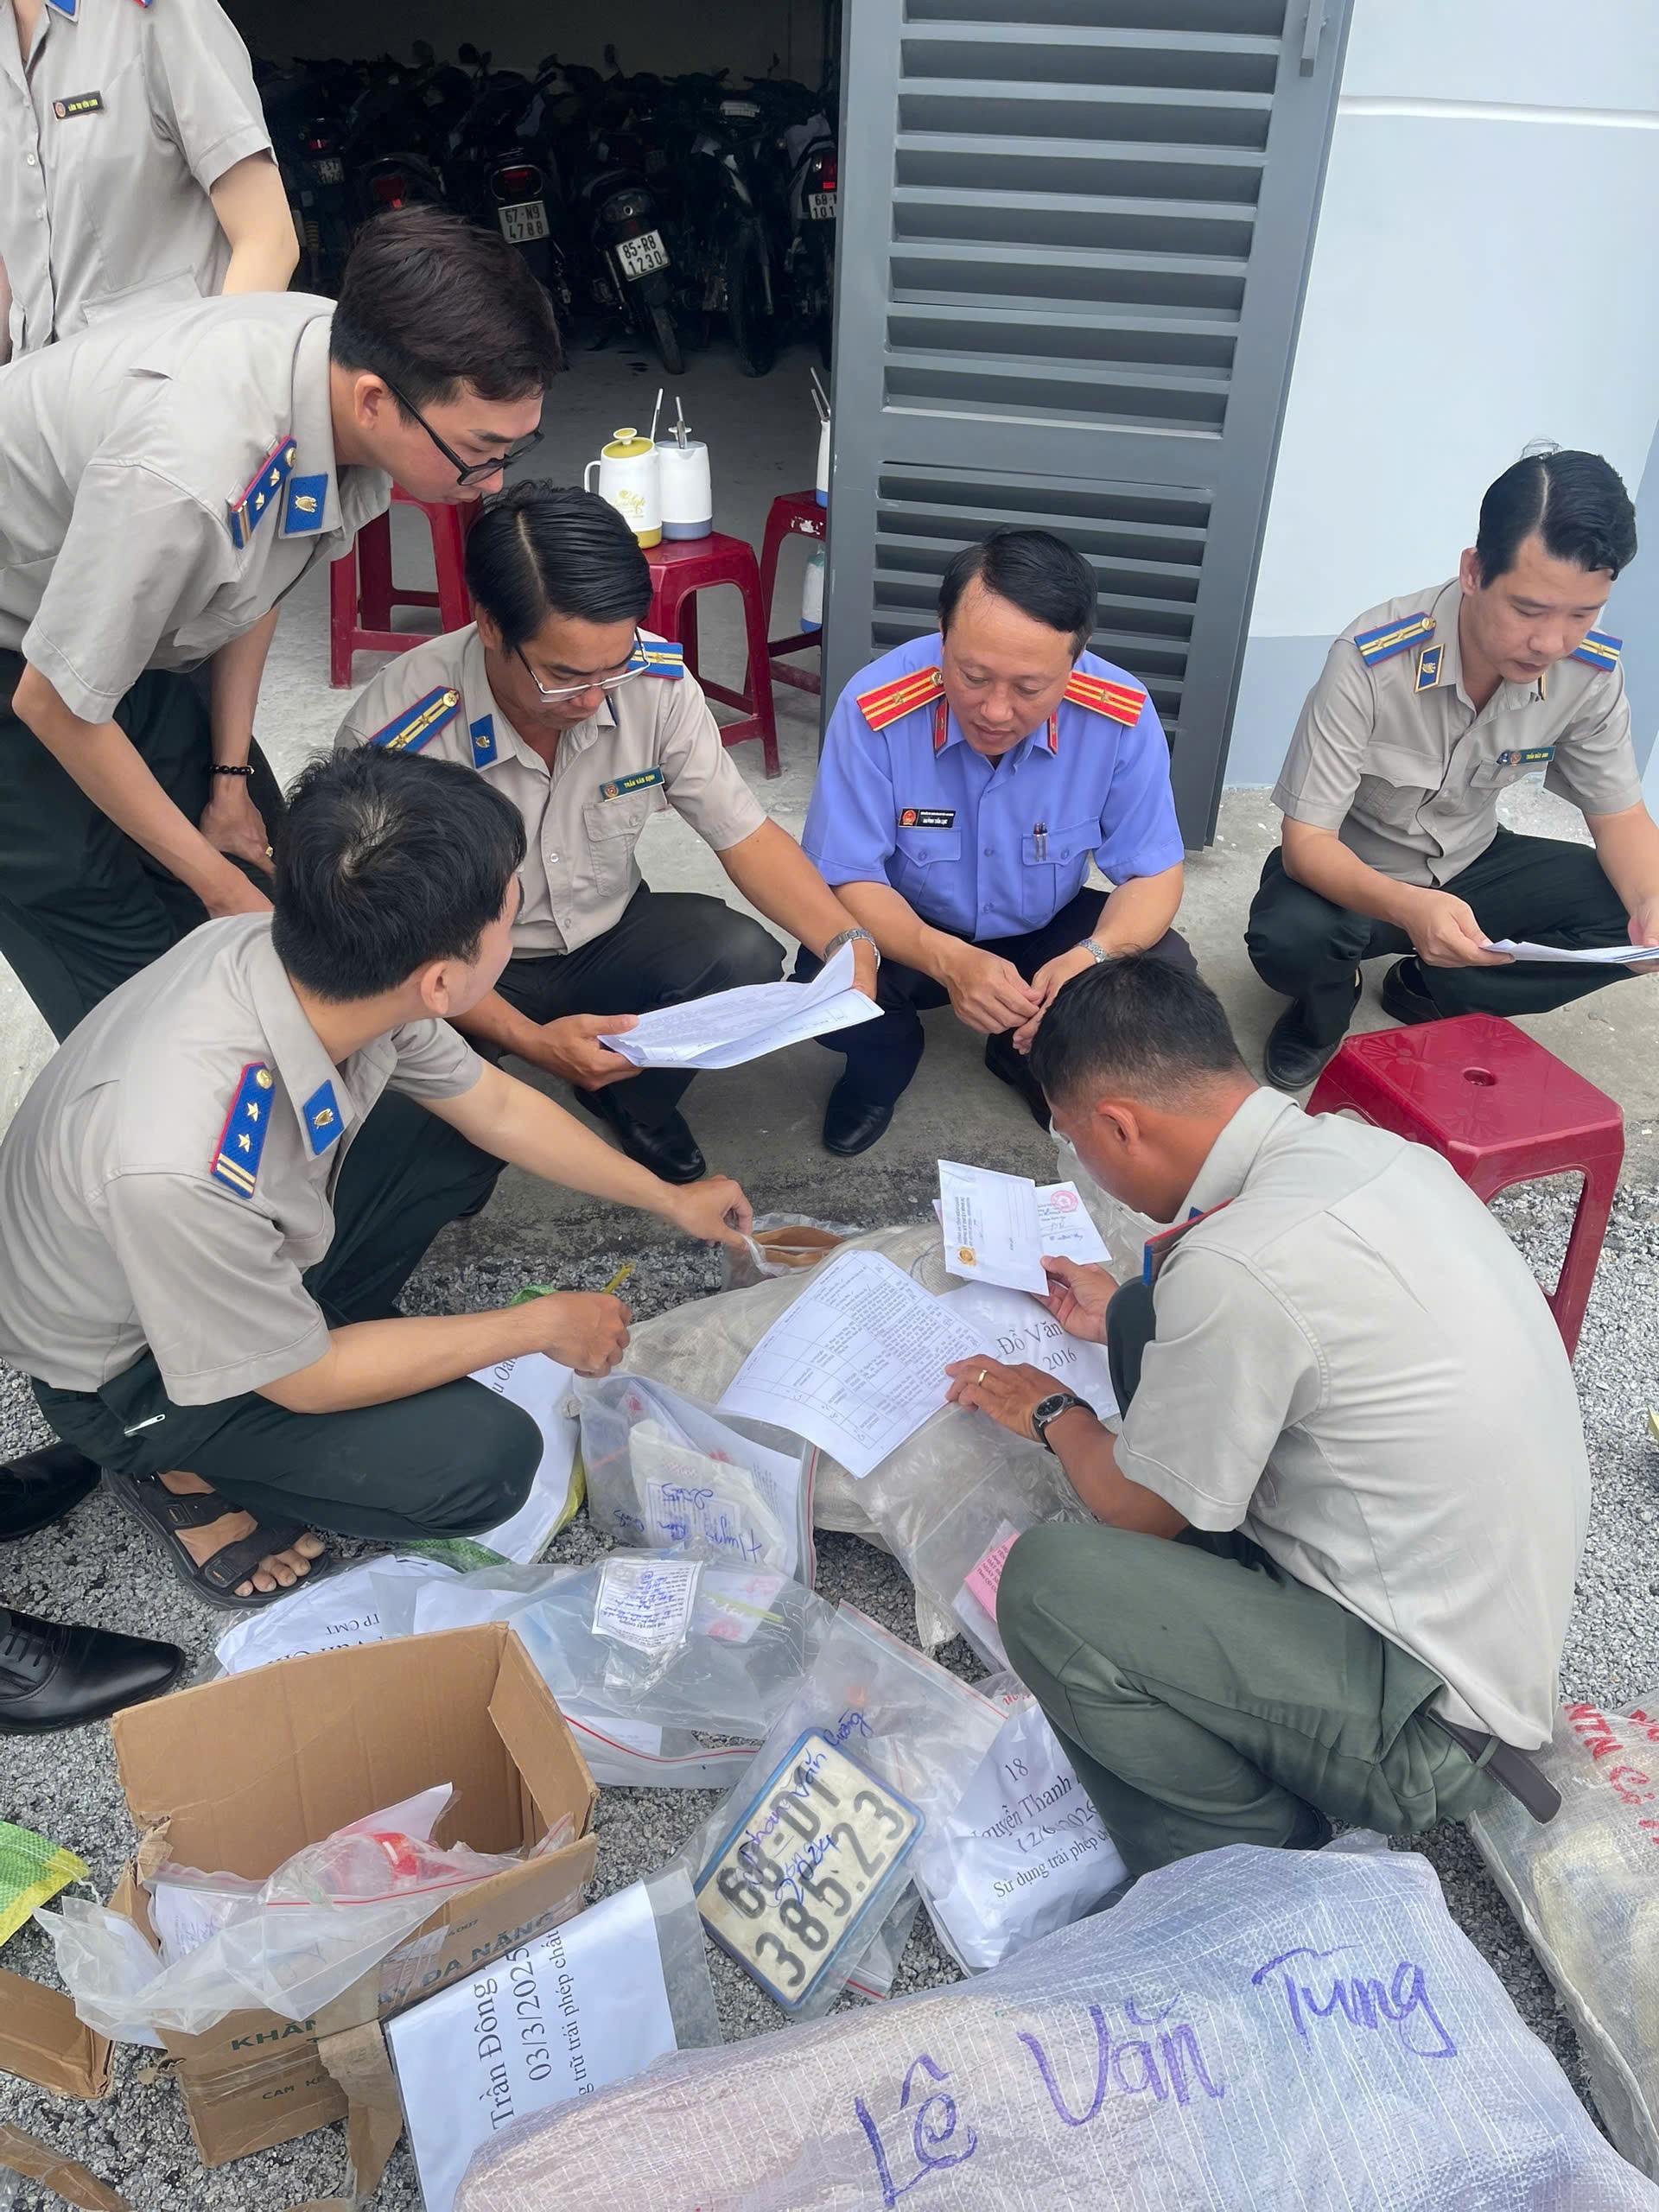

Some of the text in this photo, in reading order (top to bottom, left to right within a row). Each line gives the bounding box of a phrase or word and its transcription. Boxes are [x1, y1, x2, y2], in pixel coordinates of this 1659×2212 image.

[812, 206, 835, 218] 101
[628, 250, 663, 275] 1230
[996, 1320, 1063, 1355] Đỗ Văn
[1042, 1347, 1077, 1370] 2016
[325, 1613, 380, 1635] TP CMT
[1005, 1758, 1029, 1783] 18
[1018, 1775, 1072, 1818] Thanh
[994, 1877, 1015, 1898] Sử
[1016, 1863, 1051, 1886] dụng
[1048, 1848, 1071, 1870] trái
[1070, 1835, 1098, 1861] phép
[755, 1789, 906, 1987] 385.23
[471, 1911, 554, 1962] NĂNG
[540, 1929, 566, 1969] chất
[556, 1973, 580, 2017] phép
[505, 1947, 553, 2082] 03/3/2025
[474, 1977, 515, 2130] Trần Đông
[562, 2020, 582, 2051] trái
[569, 2054, 588, 2081] trữ
[262, 2084, 296, 2101] CAM
[855, 2052, 978, 2209] Lê
[1016, 1991, 1224, 2126] Văn
